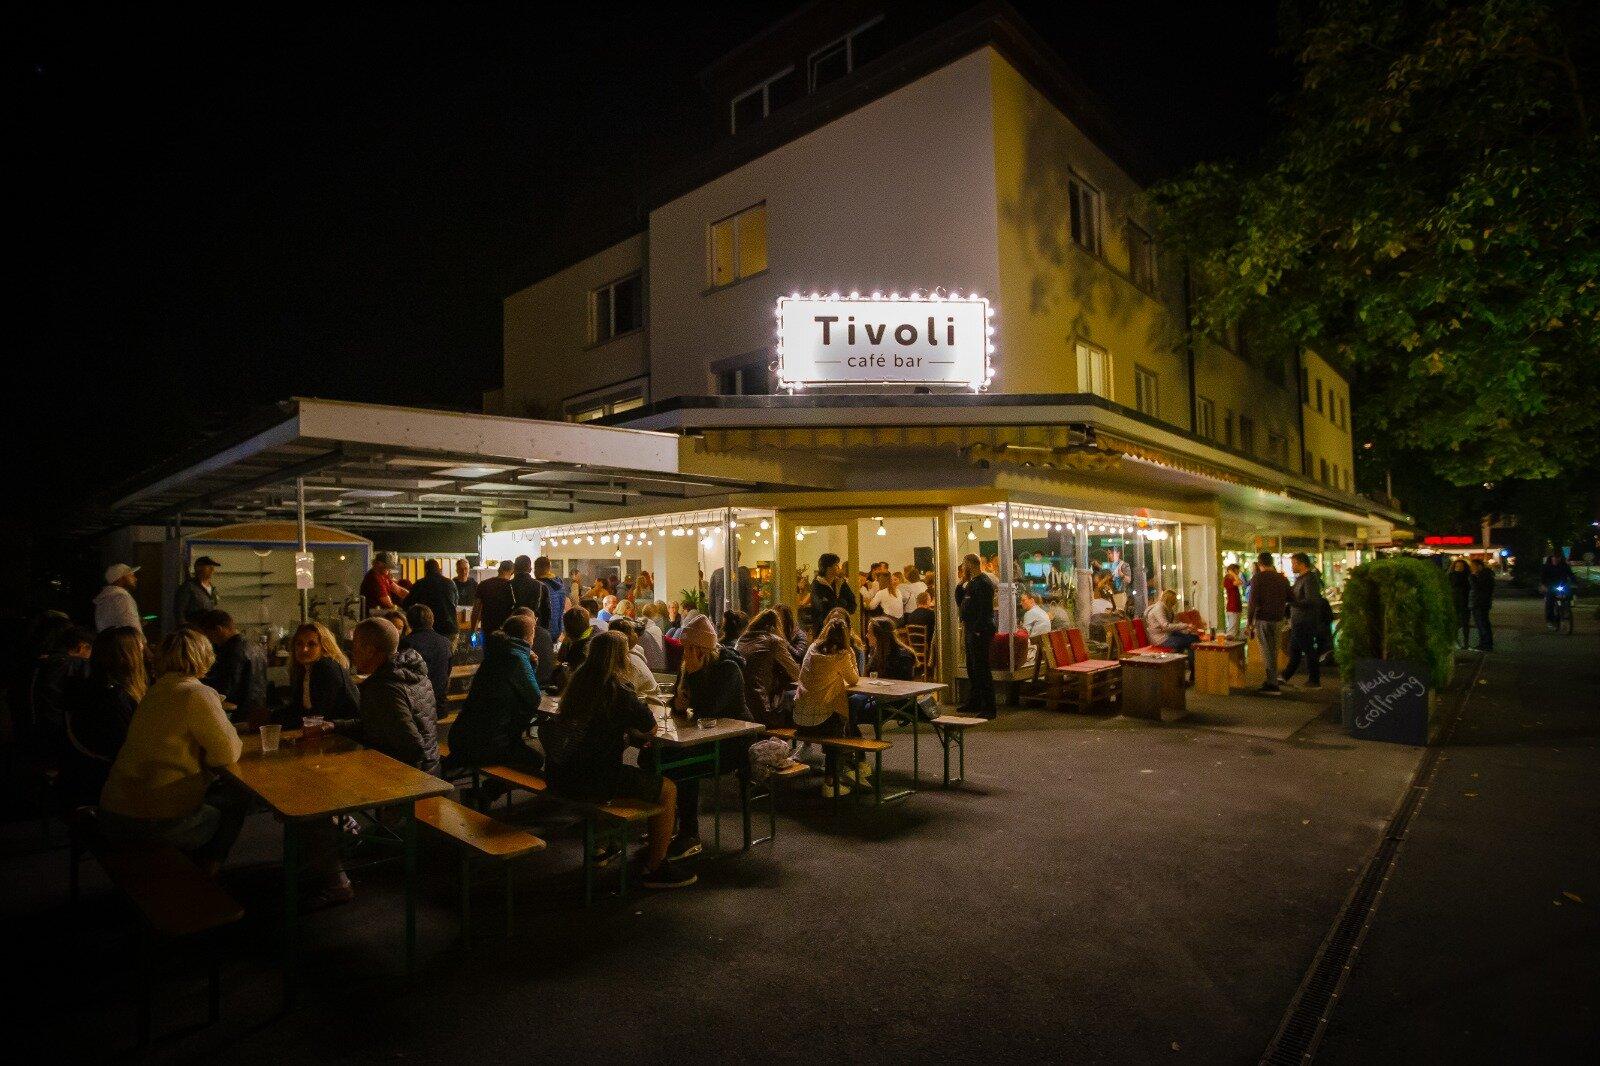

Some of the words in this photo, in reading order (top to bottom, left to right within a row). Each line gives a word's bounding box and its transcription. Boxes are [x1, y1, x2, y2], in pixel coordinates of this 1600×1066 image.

[814, 316, 955, 346] Tivoli
[847, 353, 886, 368] café
[894, 354, 923, 368] bar
[1357, 667, 1405, 694] Heute
